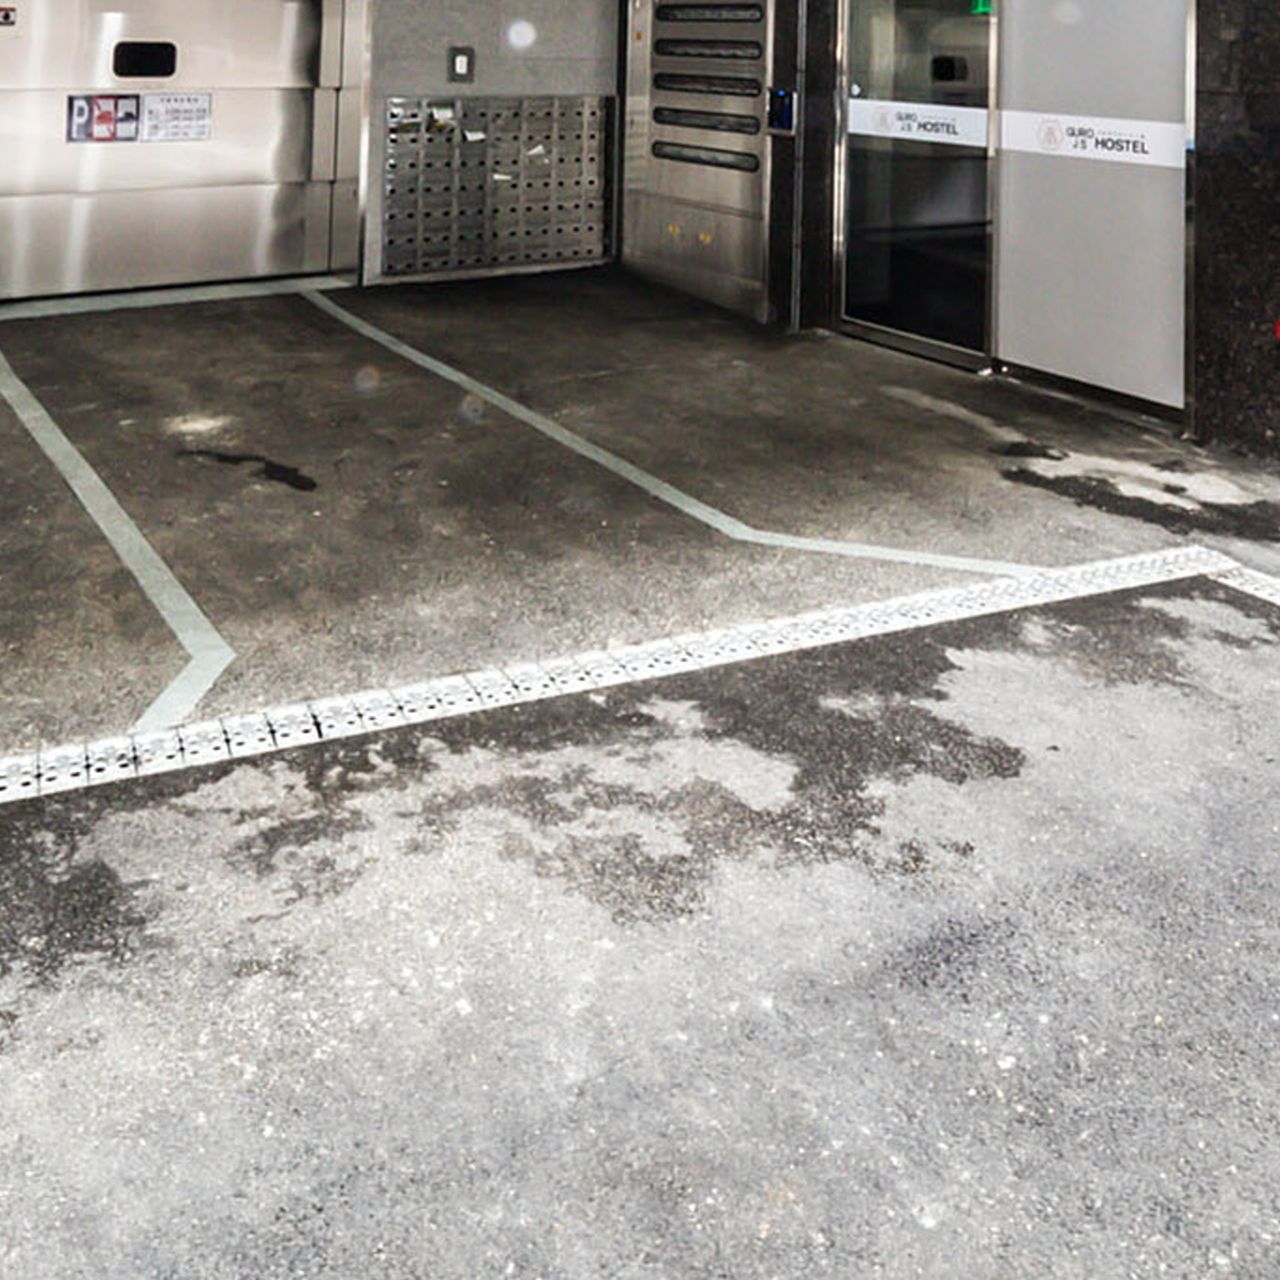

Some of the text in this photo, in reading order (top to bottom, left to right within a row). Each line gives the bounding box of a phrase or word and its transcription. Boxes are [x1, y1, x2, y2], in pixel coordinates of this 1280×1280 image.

[71, 99, 89, 139] P
[917, 121, 959, 136] HOSTEL
[1066, 126, 1095, 139] GURO
[1094, 137, 1150, 155] HOSTEL
